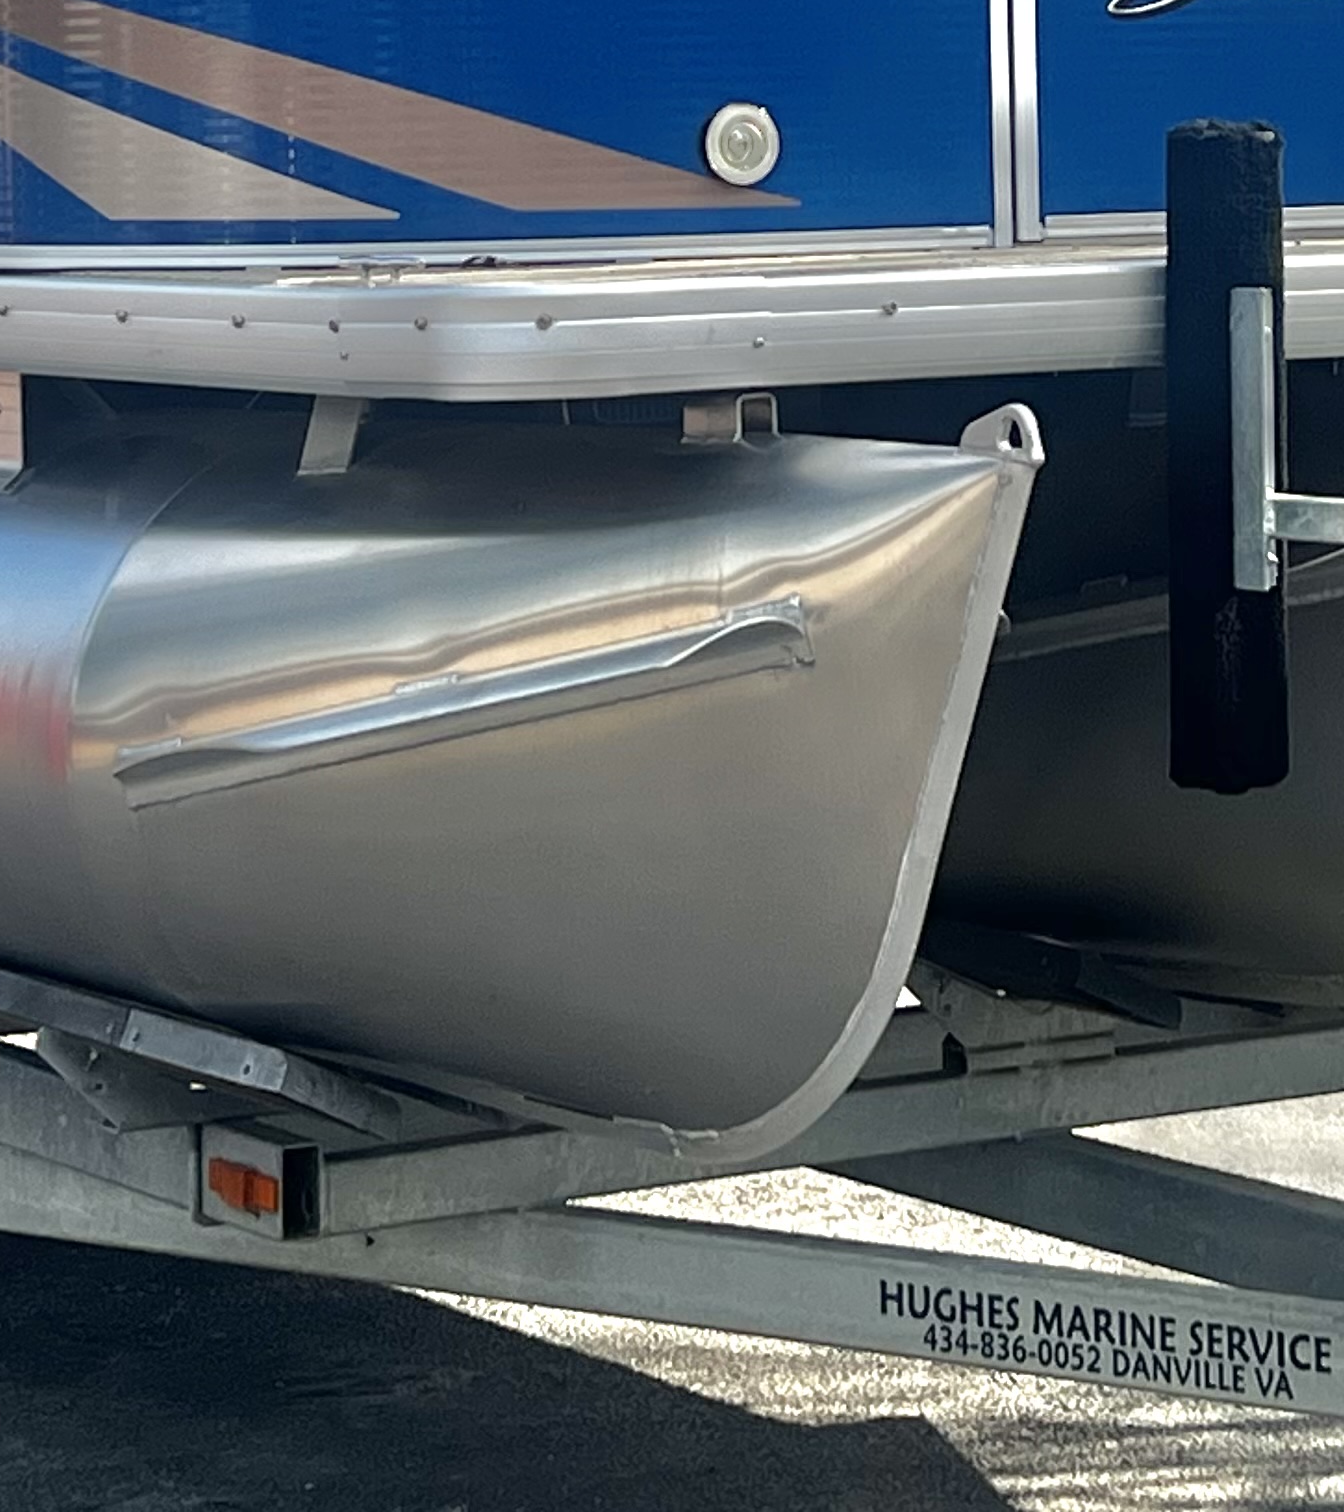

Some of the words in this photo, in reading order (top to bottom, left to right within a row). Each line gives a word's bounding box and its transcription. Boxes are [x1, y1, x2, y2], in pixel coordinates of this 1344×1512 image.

[880, 1279, 1020, 1332] HUGHES
[1032, 1299, 1176, 1353] MARINE
[1189, 1320, 1332, 1375] SERVICE
[923, 1323, 1101, 1374] 434-836-0052
[1112, 1348, 1246, 1394] DANVILLE
[1254, 1367, 1294, 1400] VA
